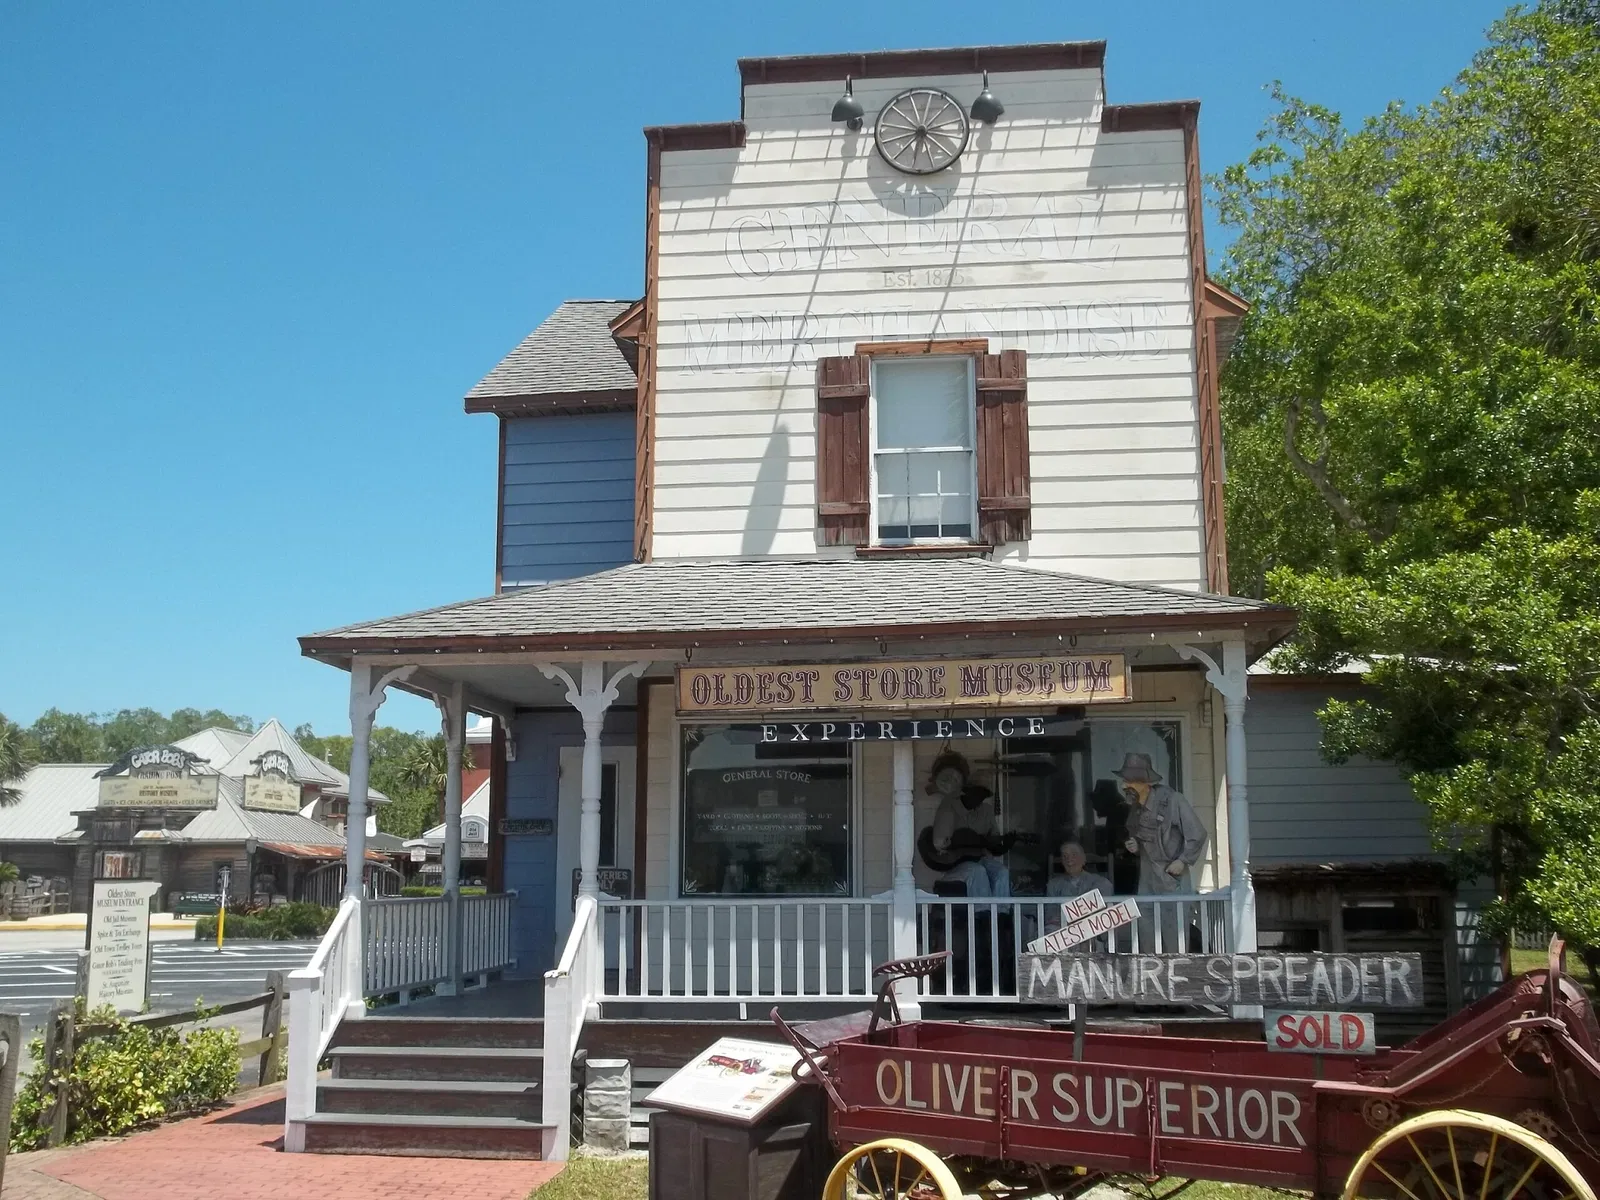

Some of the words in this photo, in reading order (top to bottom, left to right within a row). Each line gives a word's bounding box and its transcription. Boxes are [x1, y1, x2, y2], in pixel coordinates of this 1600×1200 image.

[726, 188, 1122, 285] GENERAL
[881, 269, 918, 289] Est.
[690, 669, 820, 705] OLDEST
[833, 665, 946, 701] STORE
[959, 658, 1113, 698] MUSEUM
[760, 716, 1047, 744] EXPERIENCE
[131, 750, 160, 769] GATOR
[722, 769, 773, 783] GENERAL
[776, 769, 812, 784] STORE
[97, 899, 119, 908] MUSEUM
[119, 898, 144, 907] ENTRANCE
[107, 888, 123, 898] Oldest
[124, 888, 137, 898] Store
[1064, 892, 1099, 921] NEW
[103, 915, 112, 923] Old
[1087, 903, 1137, 935] MODEL
[97, 930, 108, 940] Spice
[94, 945, 103, 953] Old
[104, 944, 115, 952] Town
[1026, 956, 1193, 1002] MANURE
[1203, 955, 1415, 1004] SPREADER
[1275, 1012, 1365, 1050] SOLD
[876, 1058, 1040, 1121] OLIVER
[1052, 1071, 1308, 1147] SUPERIOR
